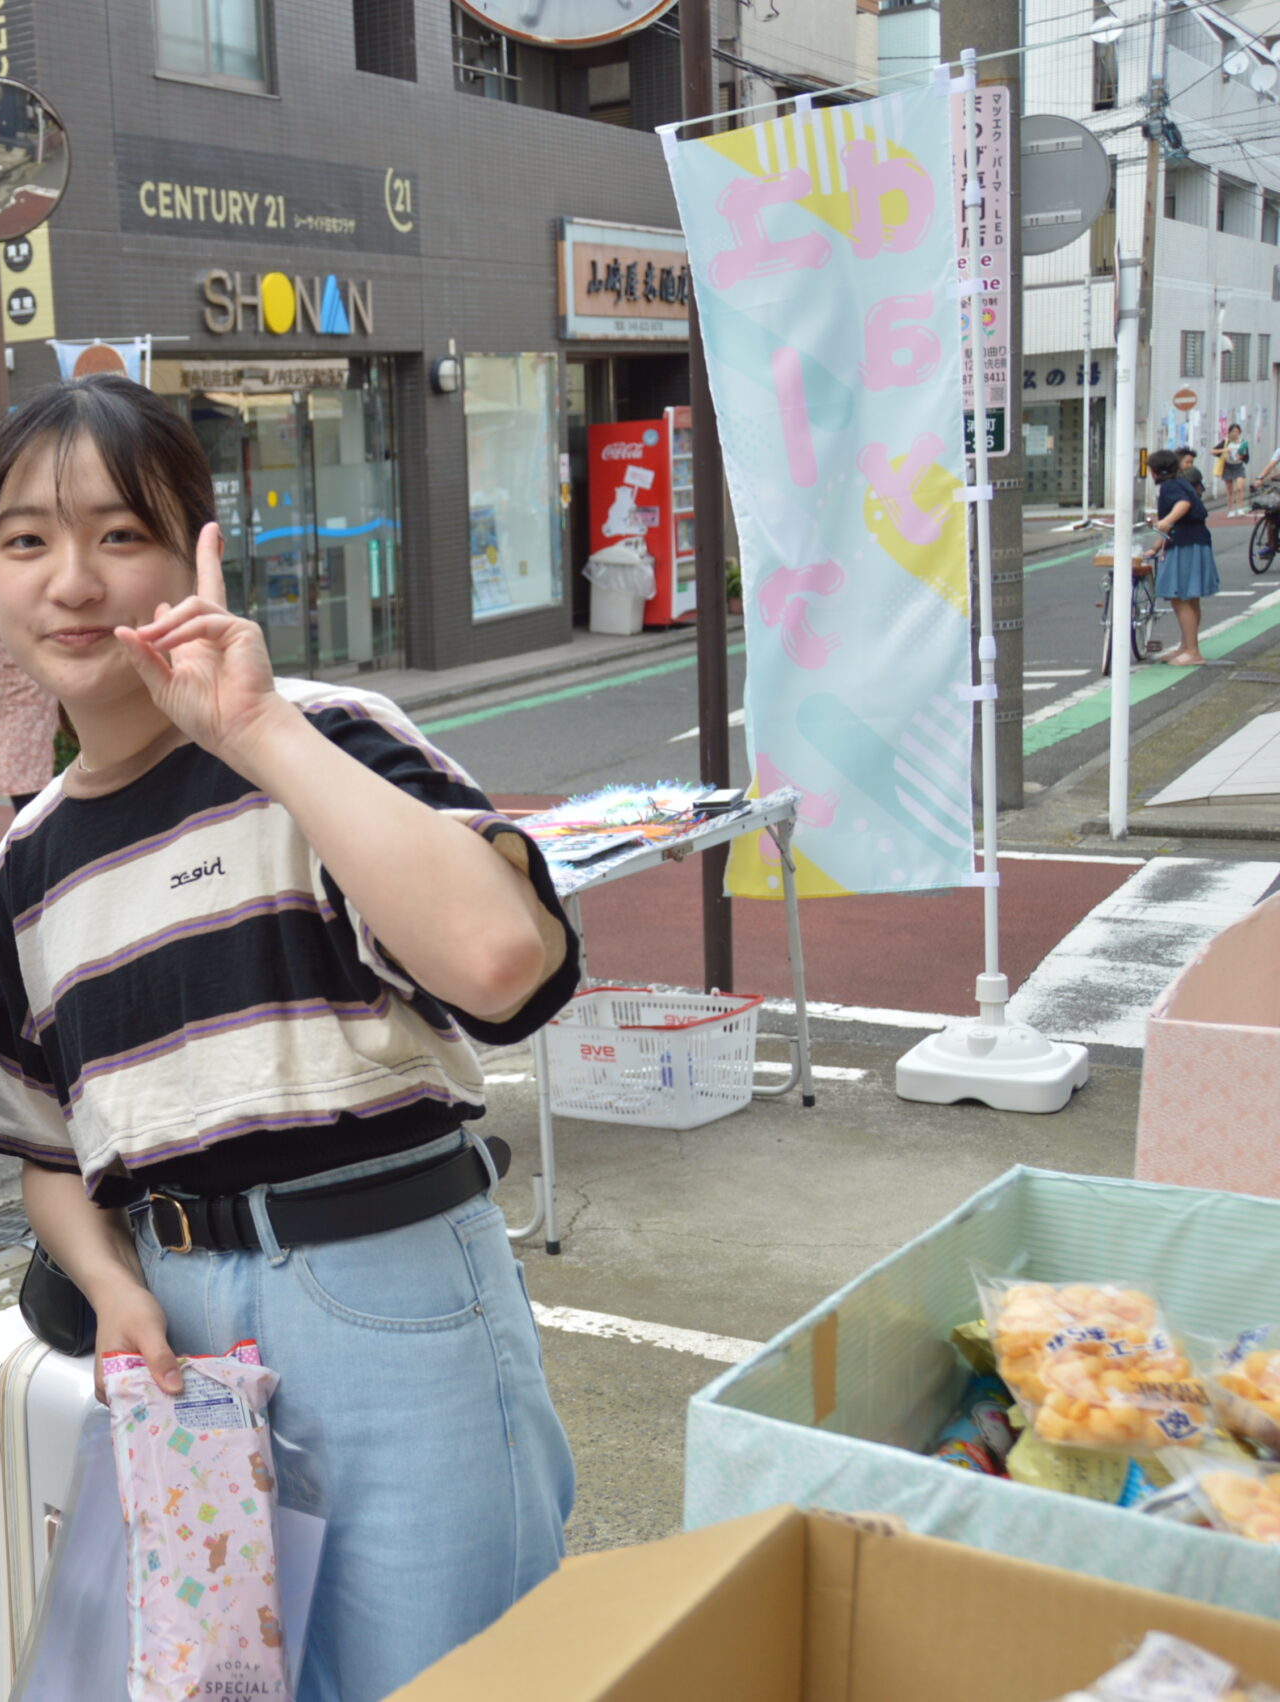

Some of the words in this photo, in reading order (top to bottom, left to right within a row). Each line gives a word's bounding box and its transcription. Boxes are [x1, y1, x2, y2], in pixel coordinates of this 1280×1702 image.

[139, 180, 258, 227] CENTURY
[265, 195, 286, 228] 21
[204, 268, 373, 334] SHONAN
[580, 1043, 615, 1056] ave
[216, 1660, 260, 1672] TODAY
[205, 1681, 269, 1694] SPECIAL
